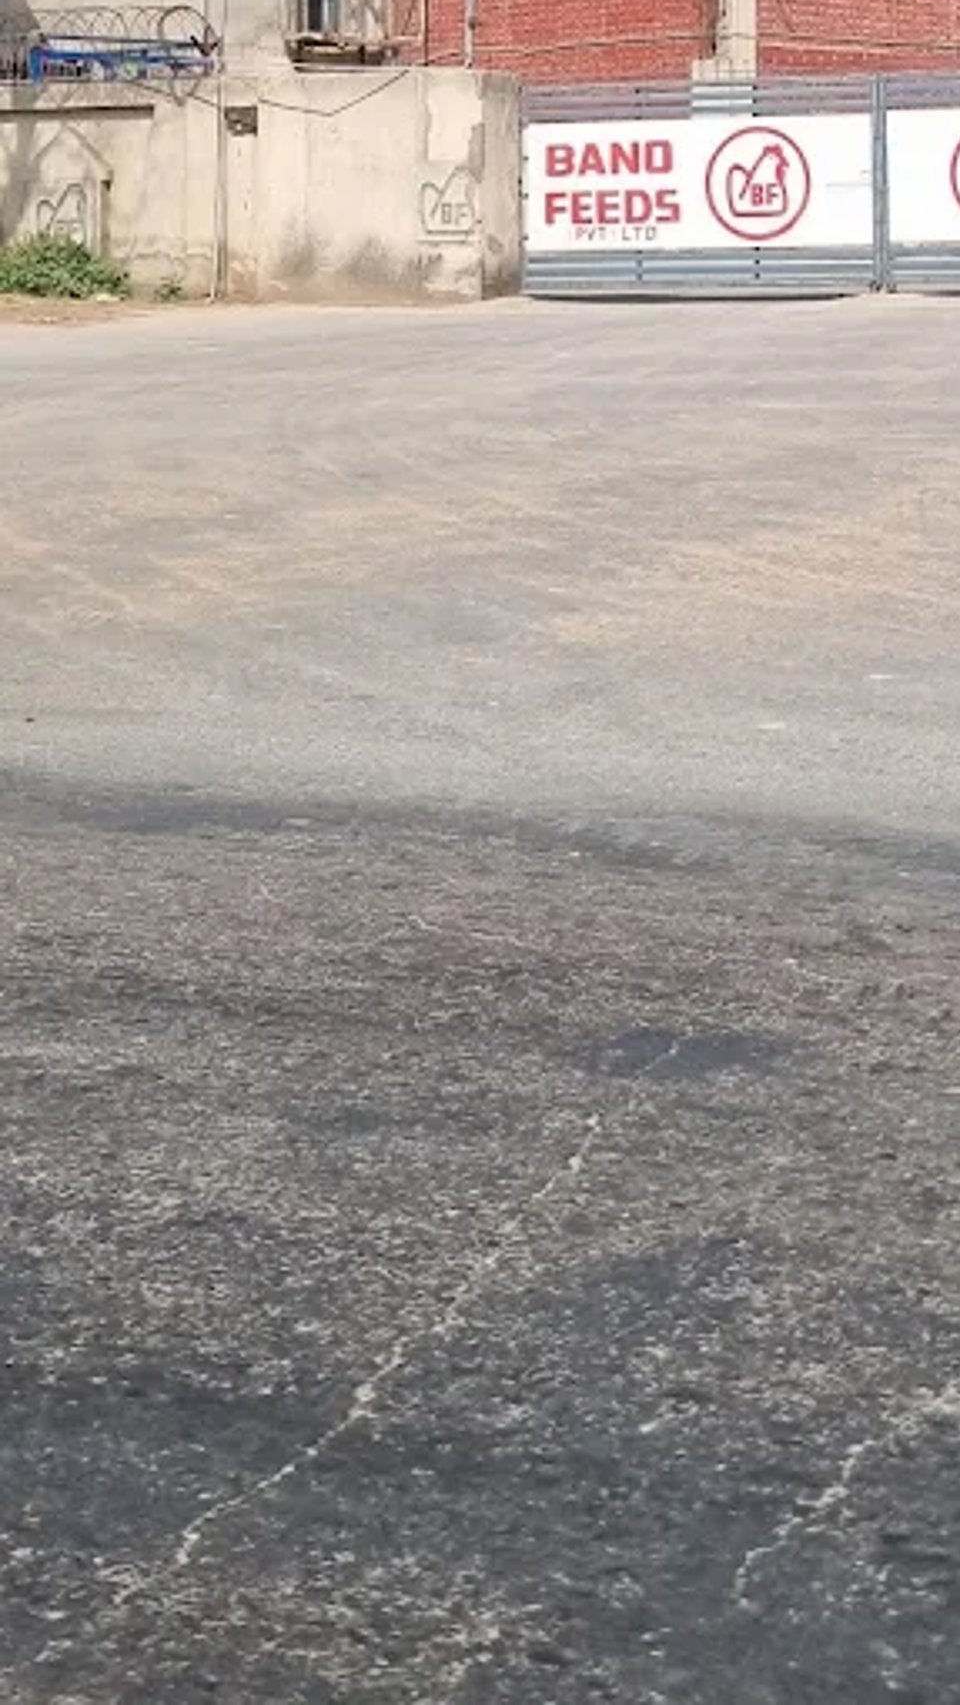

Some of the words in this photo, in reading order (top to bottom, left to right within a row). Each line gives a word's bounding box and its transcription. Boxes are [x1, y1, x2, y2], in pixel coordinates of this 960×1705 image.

[545, 140, 673, 177] BANO
[544, 189, 681, 225] FEEDS
[751, 182, 779, 207] BF
[620, 226, 656, 241] LTD
